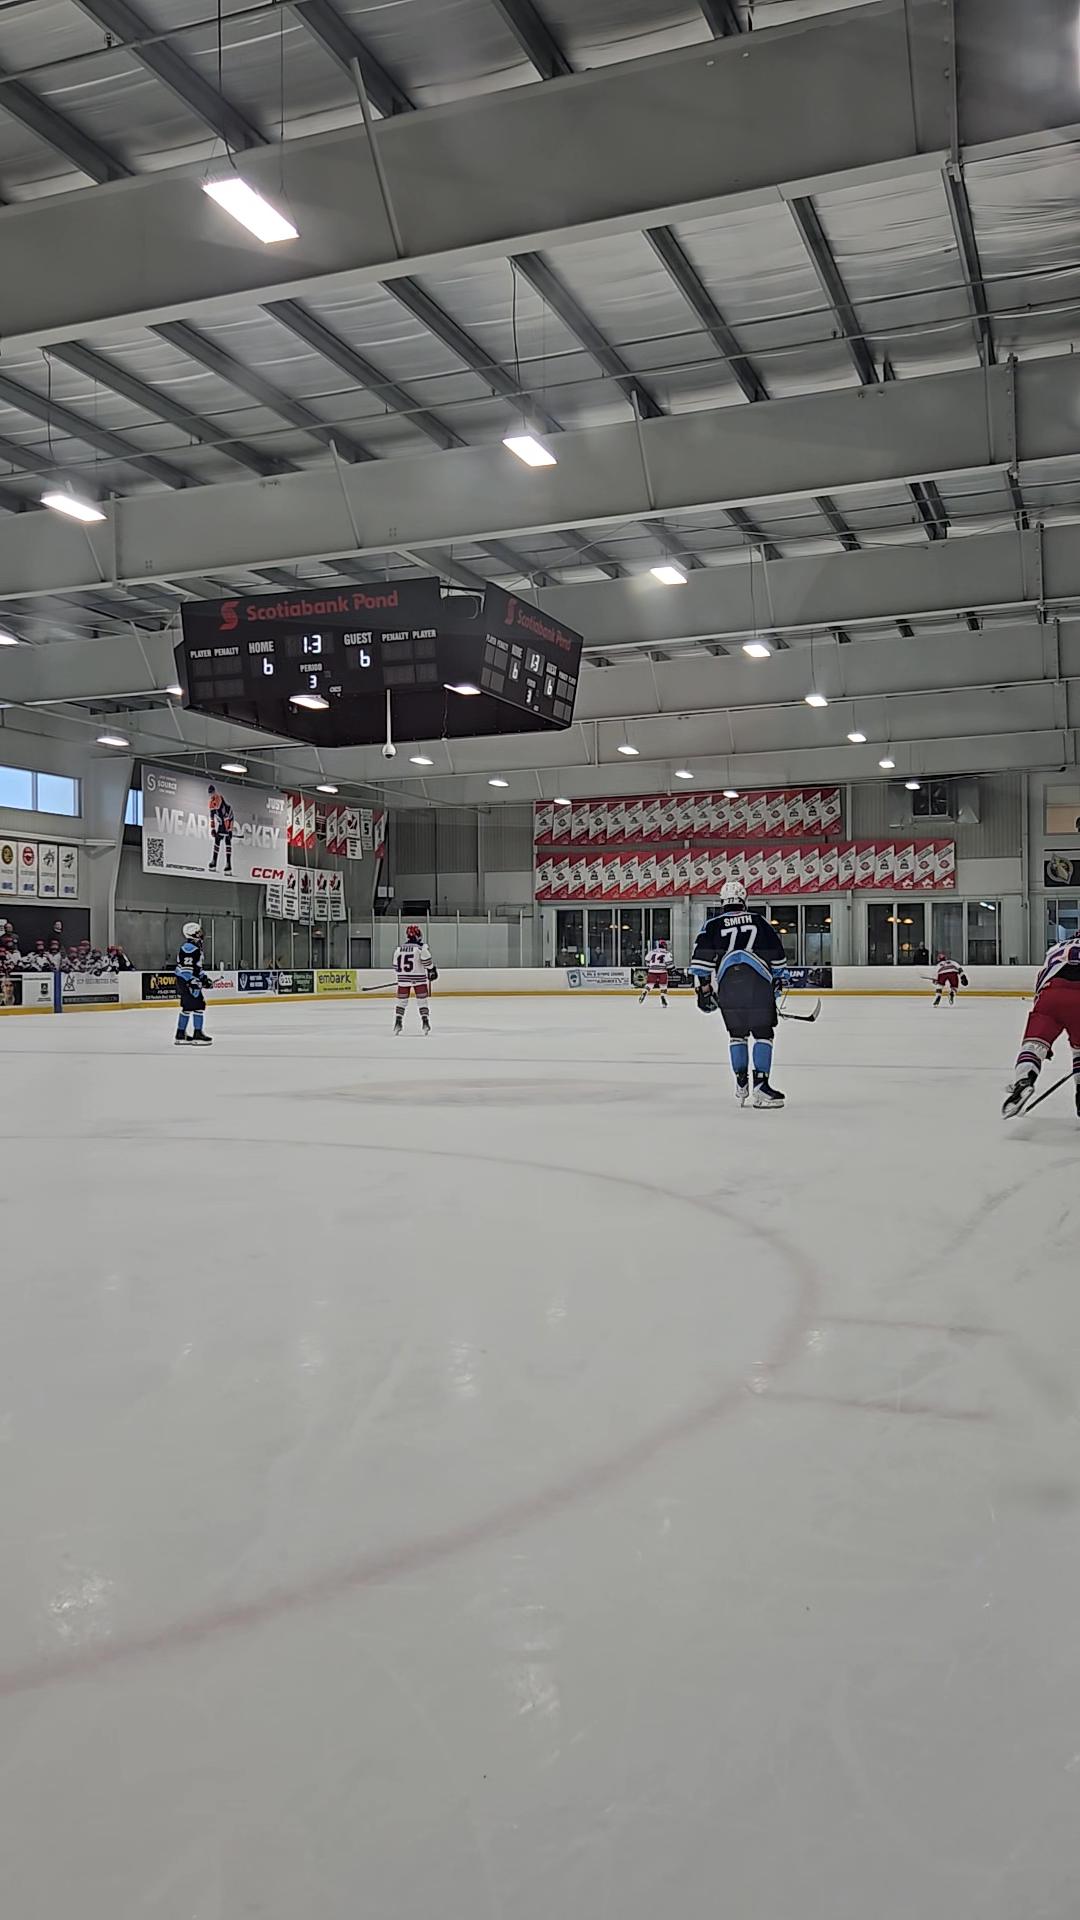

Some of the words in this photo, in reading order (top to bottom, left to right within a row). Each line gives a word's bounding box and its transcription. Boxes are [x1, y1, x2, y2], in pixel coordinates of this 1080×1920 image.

[246, 596, 349, 622] Scotiabank
[352, 589, 399, 611] Pond
[343, 631, 373, 646] GUEST
[381, 631, 409, 642] PENALTY
[412, 629, 437, 639] PLAYER
[190, 649, 212, 659] PLAYER
[214, 646, 240, 657] PENALTY
[248, 640, 275, 654] HOME
[300, 663, 323, 673] PERIOD
[309, 674, 318, 689] 3
[266, 797, 285, 812] JUST
[251, 867, 285, 880] CCM
[724, 914, 753, 927] SMITH
[720, 924, 758, 953] 77
[183, 956, 193, 966] 22
[395, 953, 415, 973] 15
[318, 971, 351, 985] embark
